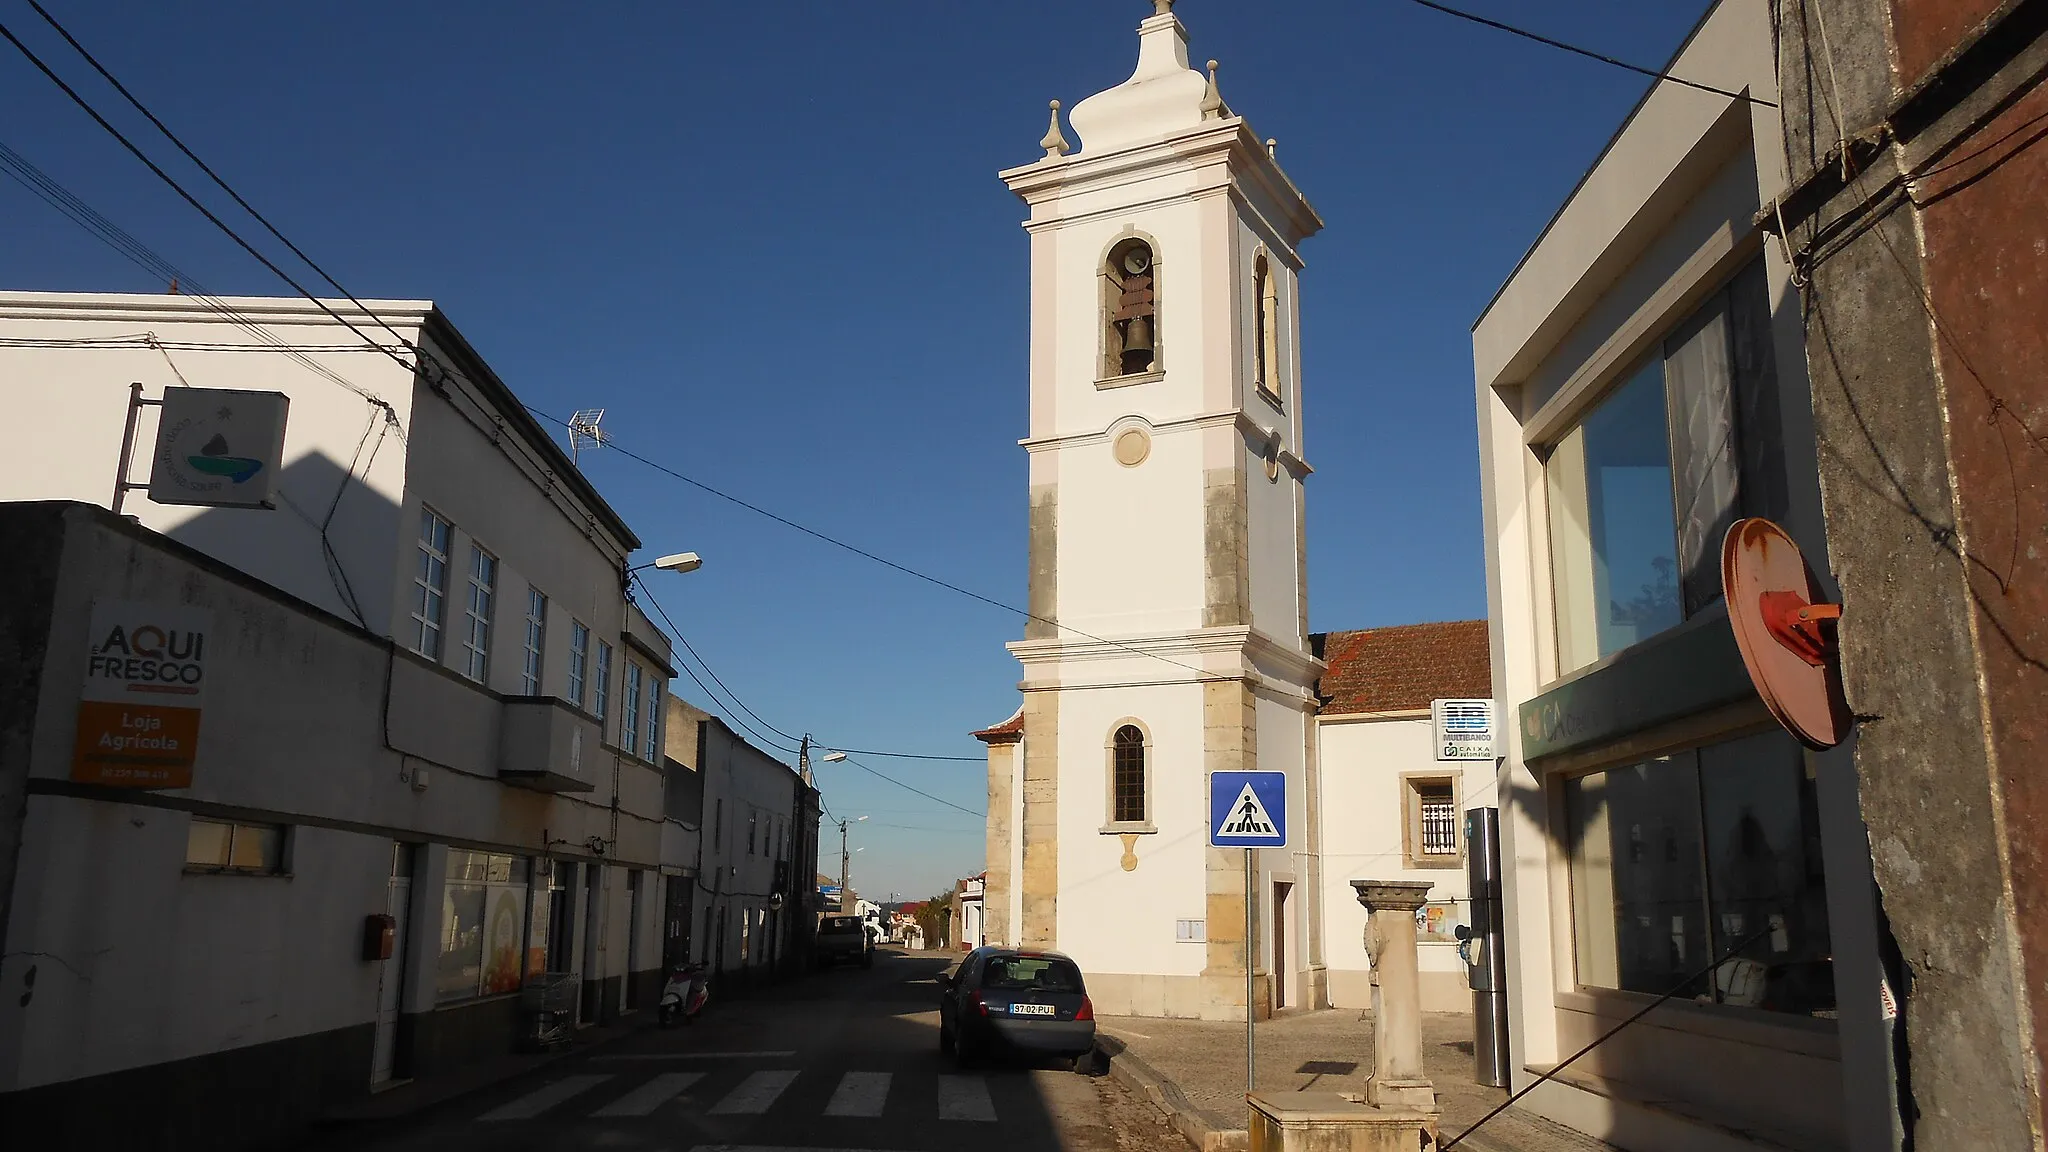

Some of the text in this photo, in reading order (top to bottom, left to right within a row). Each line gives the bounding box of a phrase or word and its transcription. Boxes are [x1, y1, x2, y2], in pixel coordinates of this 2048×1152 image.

[100, 624, 204, 661] AQUI
[88, 656, 203, 684] FRESCO
[121, 712, 162, 732] Loja
[1543, 700, 1565, 743] CA
[97, 730, 179, 750] Agrícola
